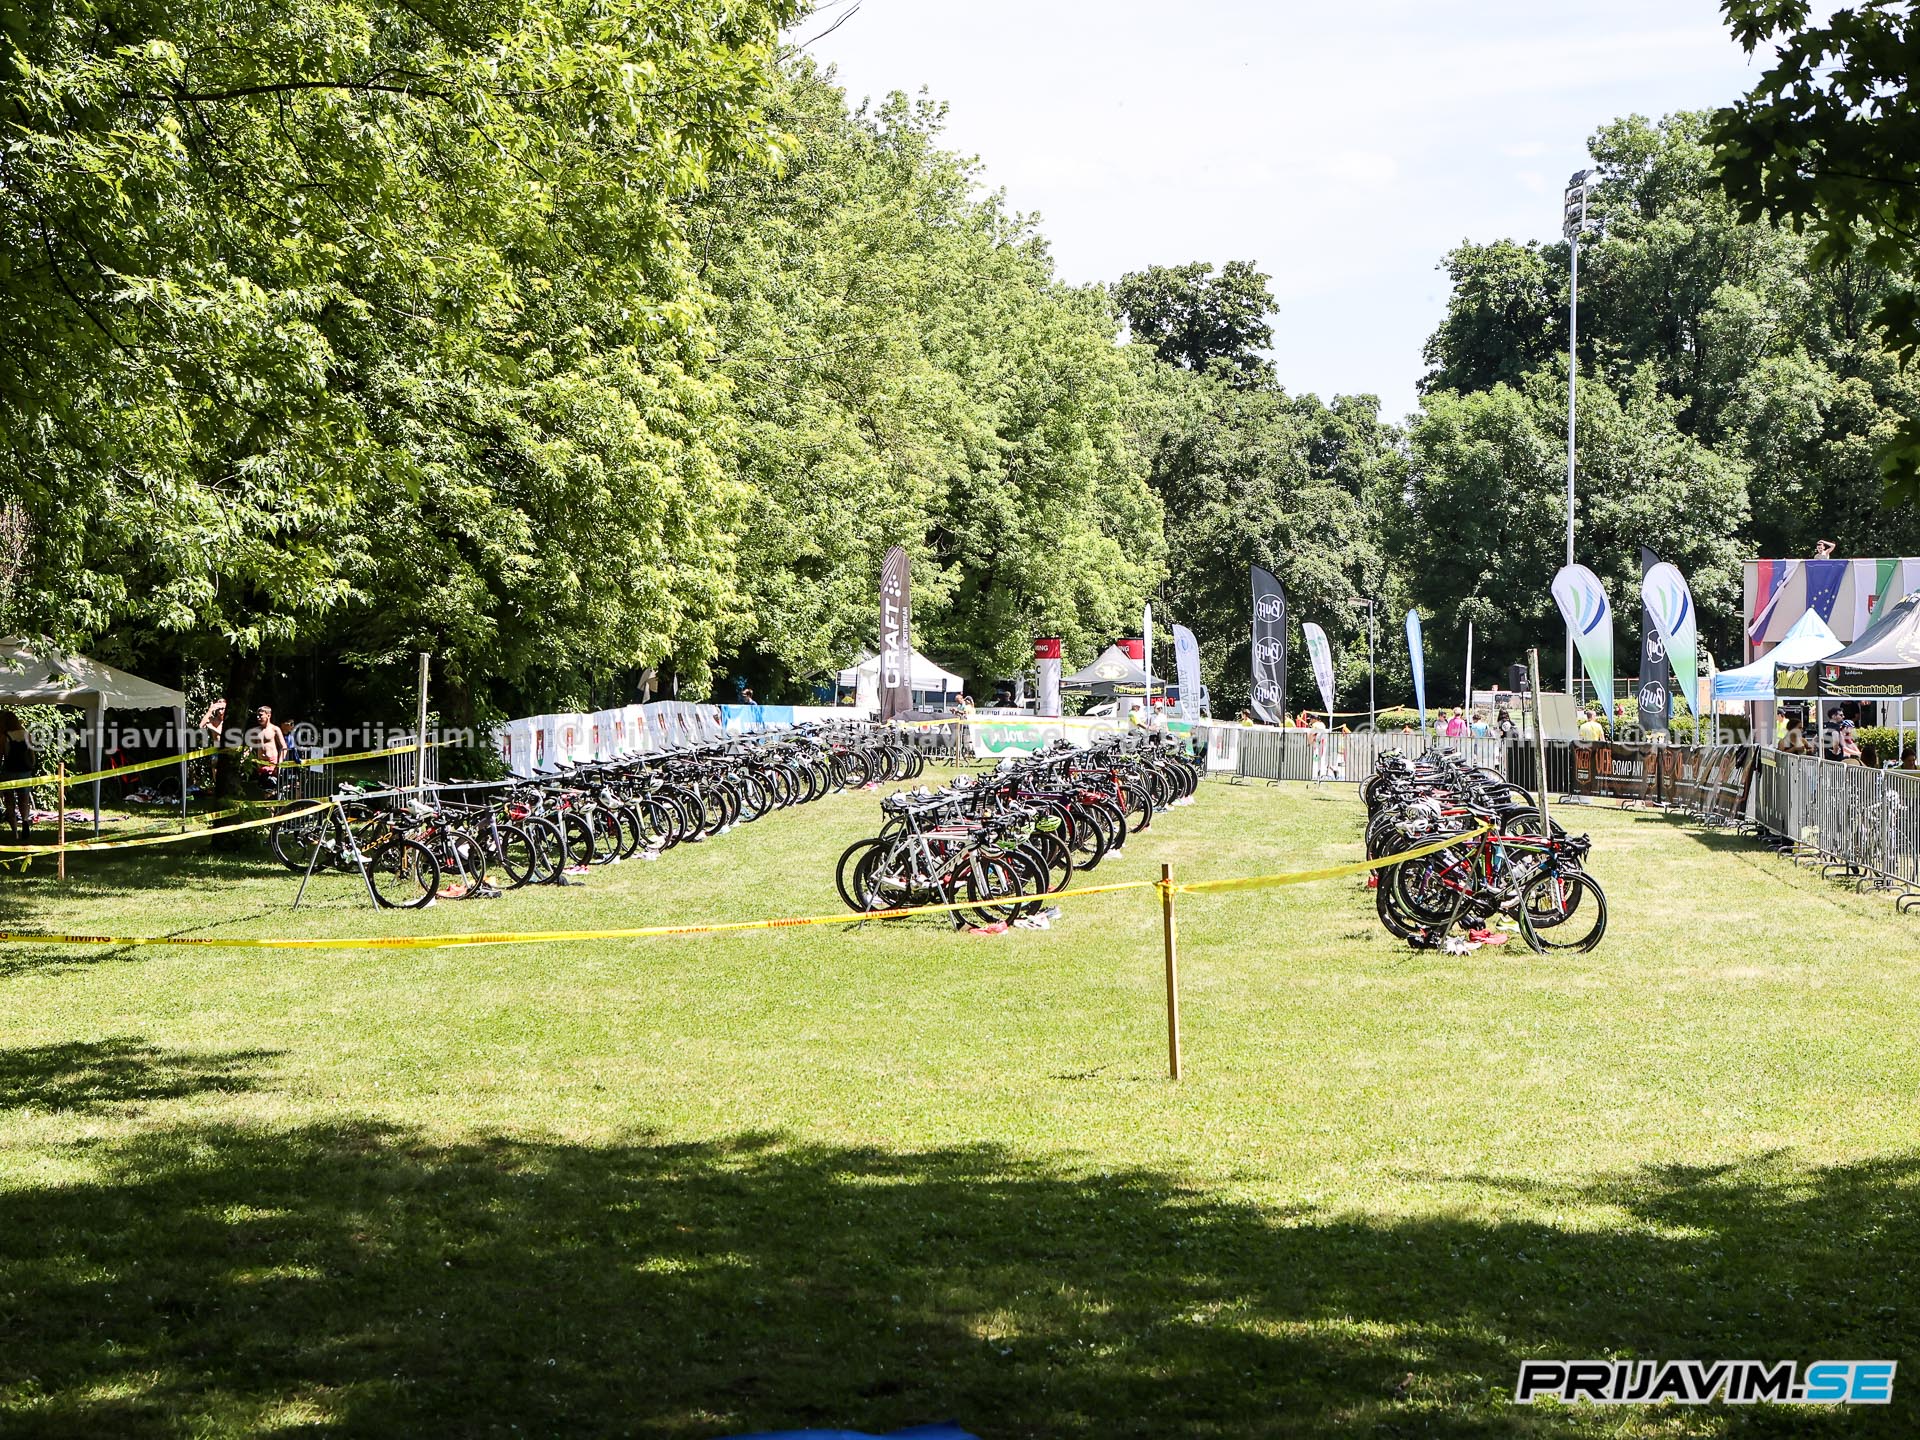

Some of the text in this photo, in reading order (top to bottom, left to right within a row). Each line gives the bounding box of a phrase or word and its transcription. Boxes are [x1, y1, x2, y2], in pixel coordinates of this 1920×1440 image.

[885, 598, 900, 688] CRAFT
[1612, 760, 1644, 777] COMPANY
[65, 935, 111, 943] TIMING
